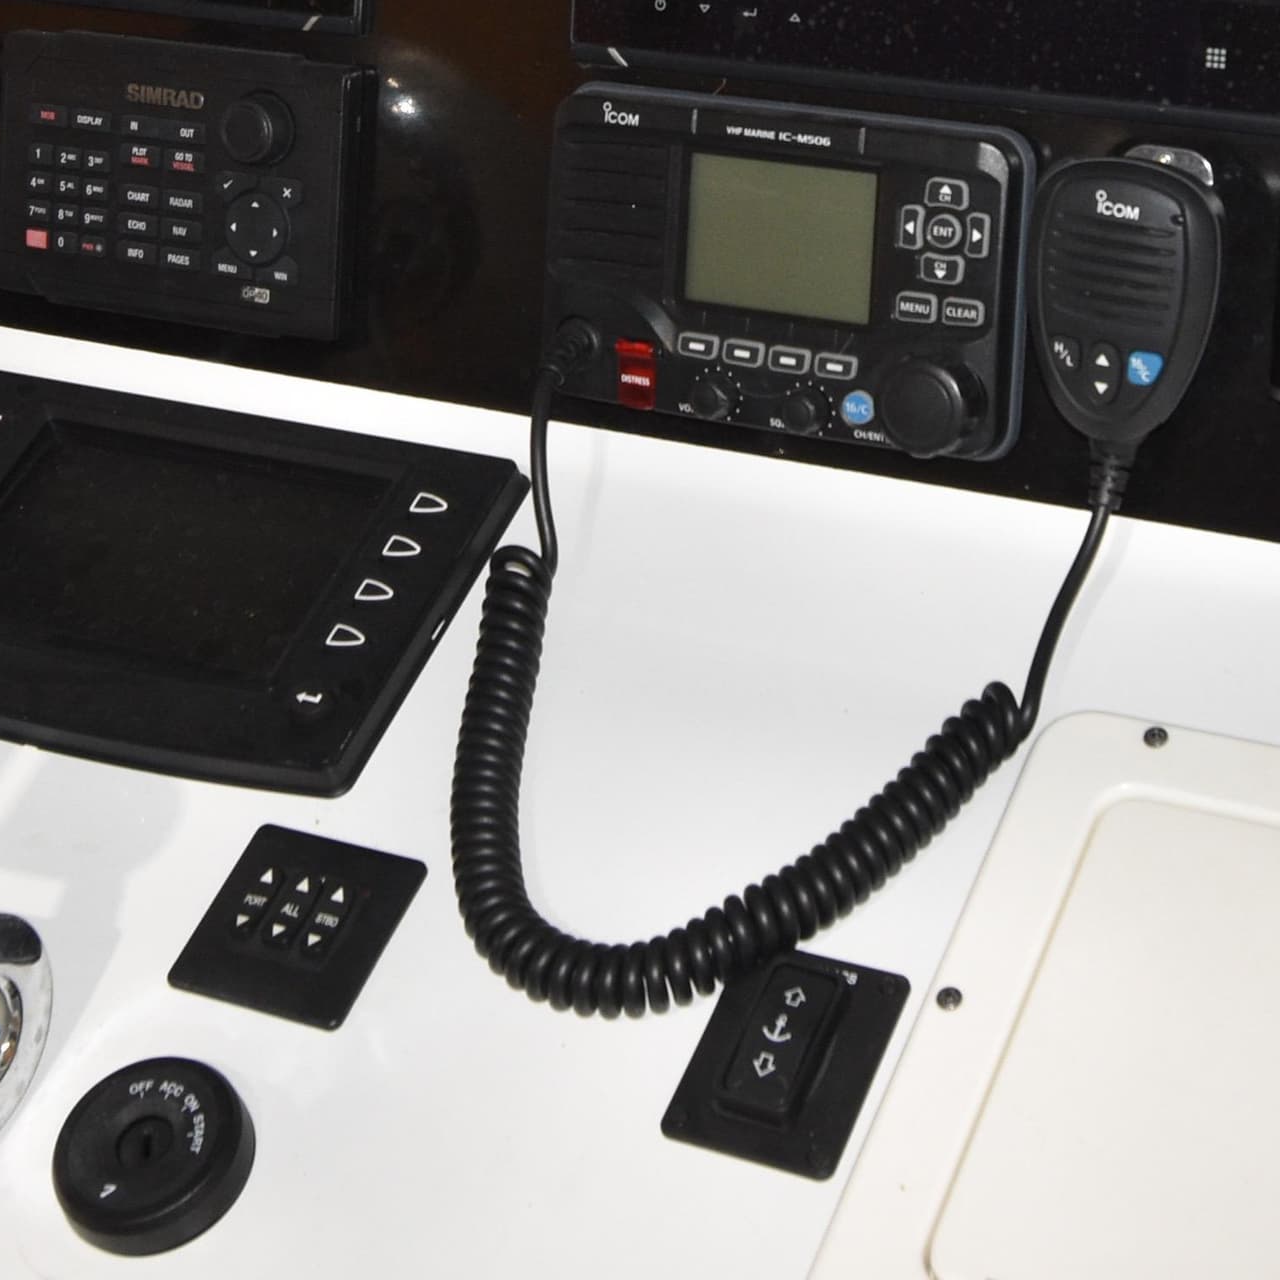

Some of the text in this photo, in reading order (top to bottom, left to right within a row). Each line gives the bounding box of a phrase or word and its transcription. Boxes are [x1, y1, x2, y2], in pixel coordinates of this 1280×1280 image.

[127, 83, 204, 110] SIMRAD
[778, 131, 831, 147] IC-M506
[35, 147, 40, 160] 1
[127, 190, 150, 203] CHART
[127, 219, 147, 232] ECHO
[933, 225, 954, 238] ENT
[167, 253, 191, 266] PAGES
[900, 301, 931, 315] MENU
[946, 306, 978, 320] CLEAR
[621, 372, 651, 387] DISTRESS
[678, 402, 694, 414] VO
[281, 903, 300, 918] ALL
[129, 1079, 205, 1154] OFF ACC ON START
